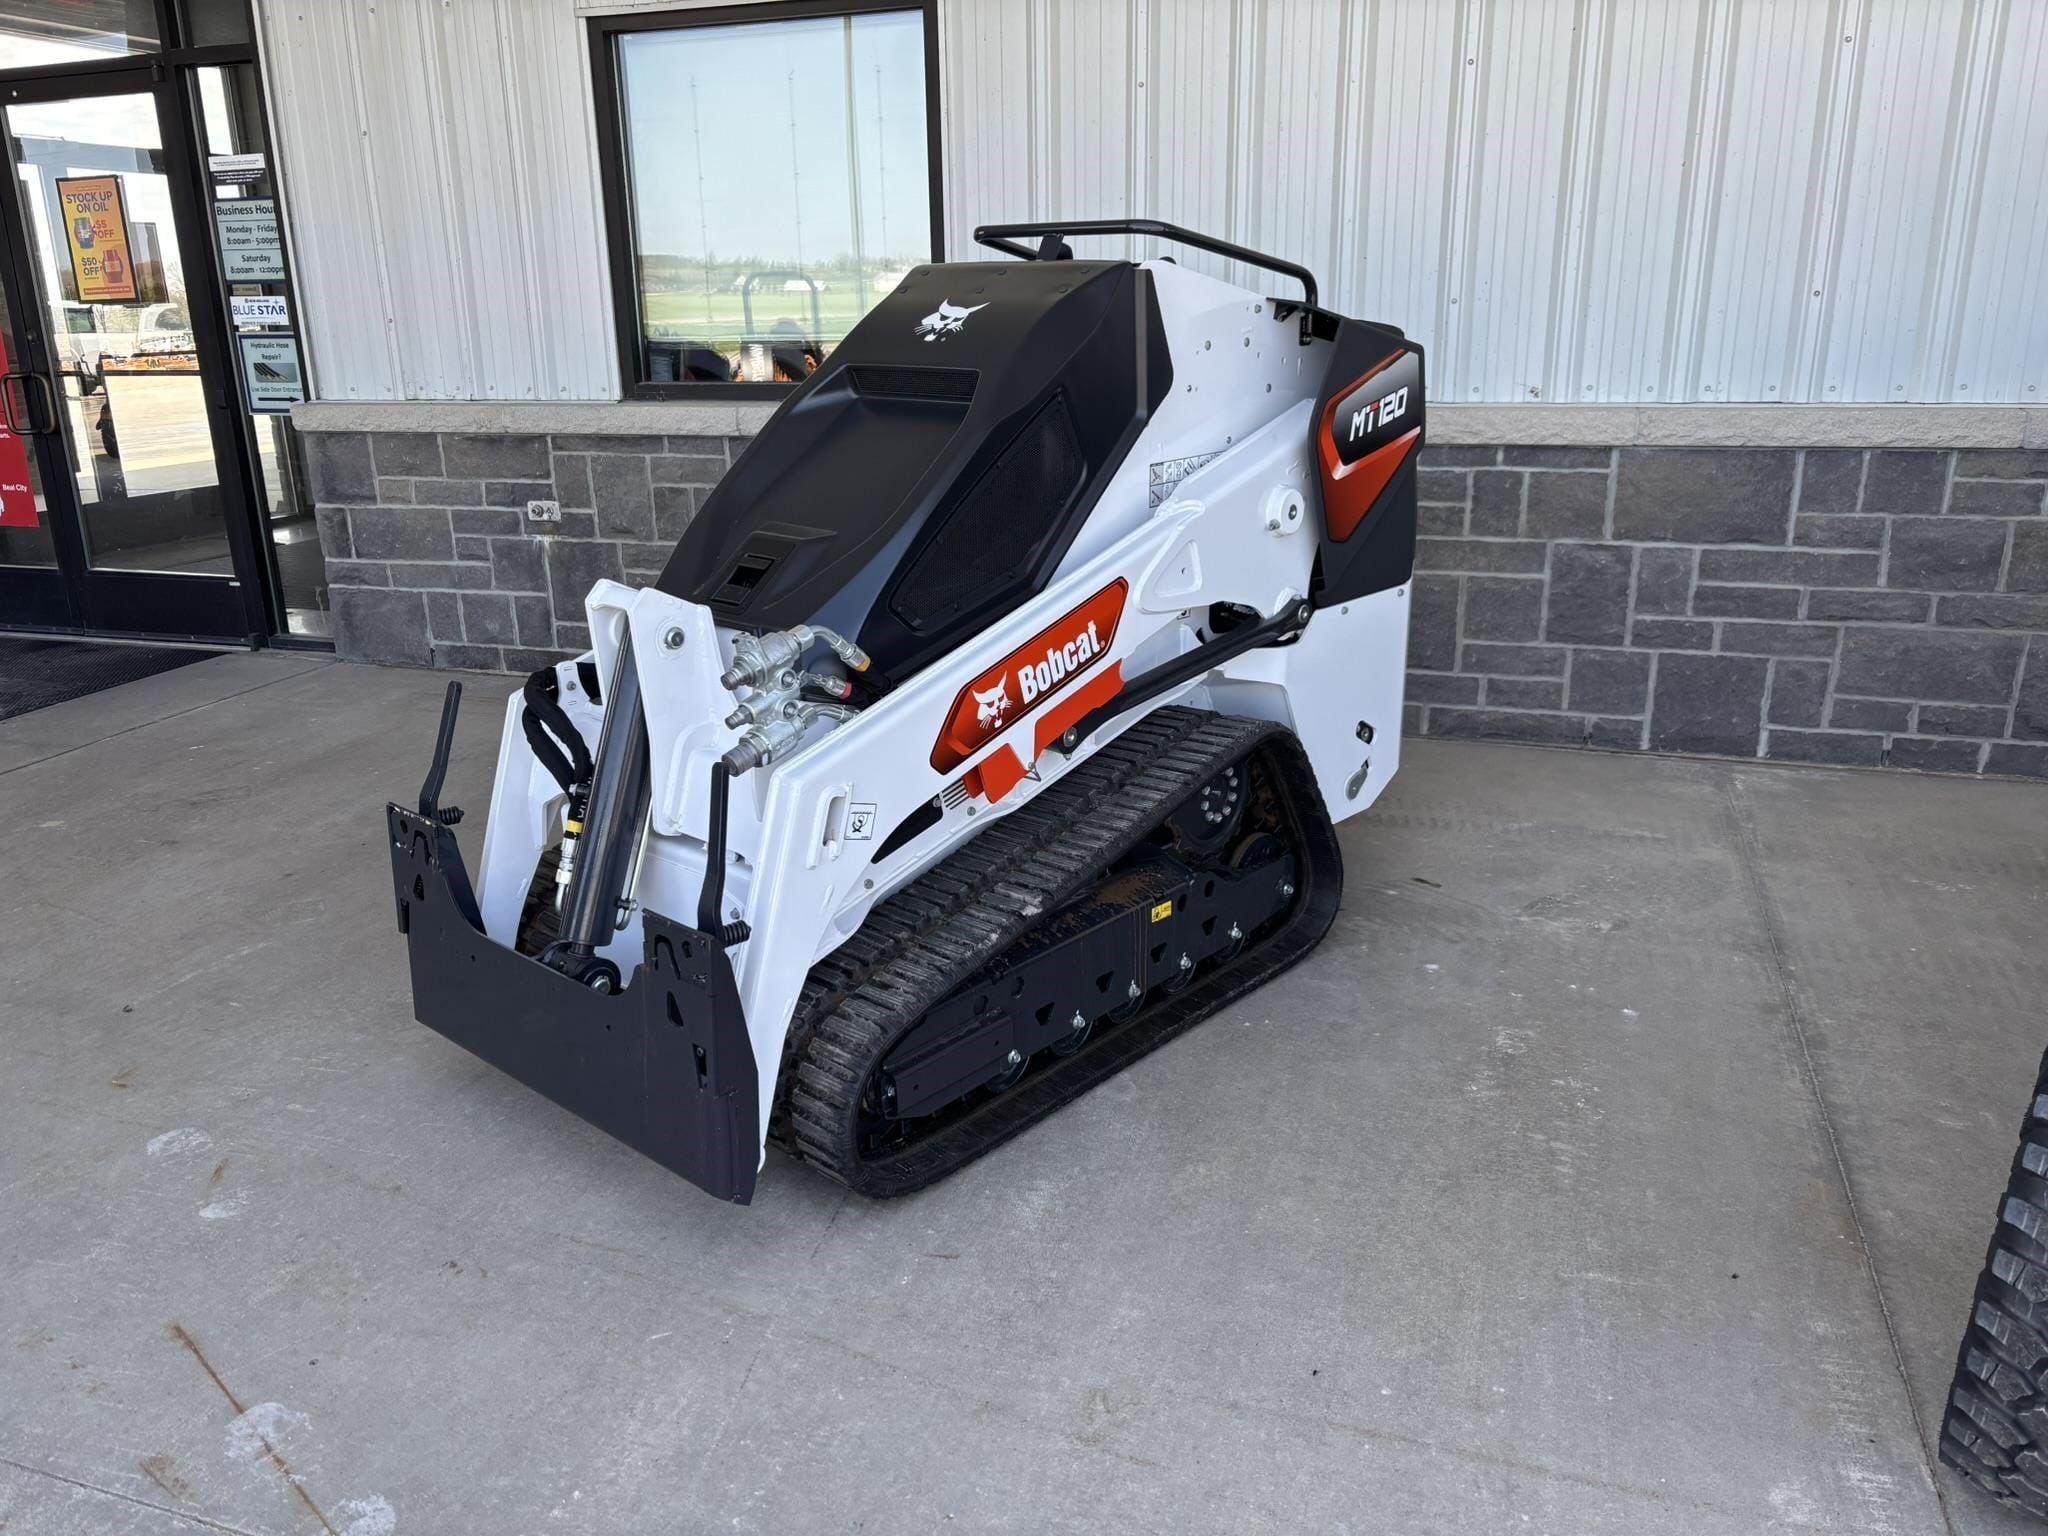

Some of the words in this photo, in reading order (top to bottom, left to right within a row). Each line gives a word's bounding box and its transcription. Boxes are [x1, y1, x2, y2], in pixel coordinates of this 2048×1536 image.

[66, 192, 98, 204] STOCK
[99, 191, 113, 201] UP
[76, 204, 91, 213] ON
[93, 202, 109, 212] OIL
[216, 205, 254, 216] Business
[97, 229, 115, 239] OFF
[226, 225, 253, 234] Monday
[257, 224, 278, 234] Friday
[81, 257, 97, 266] $50
[241, 254, 271, 263] Saturday
[83, 266, 99, 276] OFF
[233, 305, 257, 316] BLUE
[257, 305, 287, 316] STAR
[261, 353, 281, 361] Repair?
[15, 483, 28, 493] City
[1017, 619, 1101, 705] Bobcat
